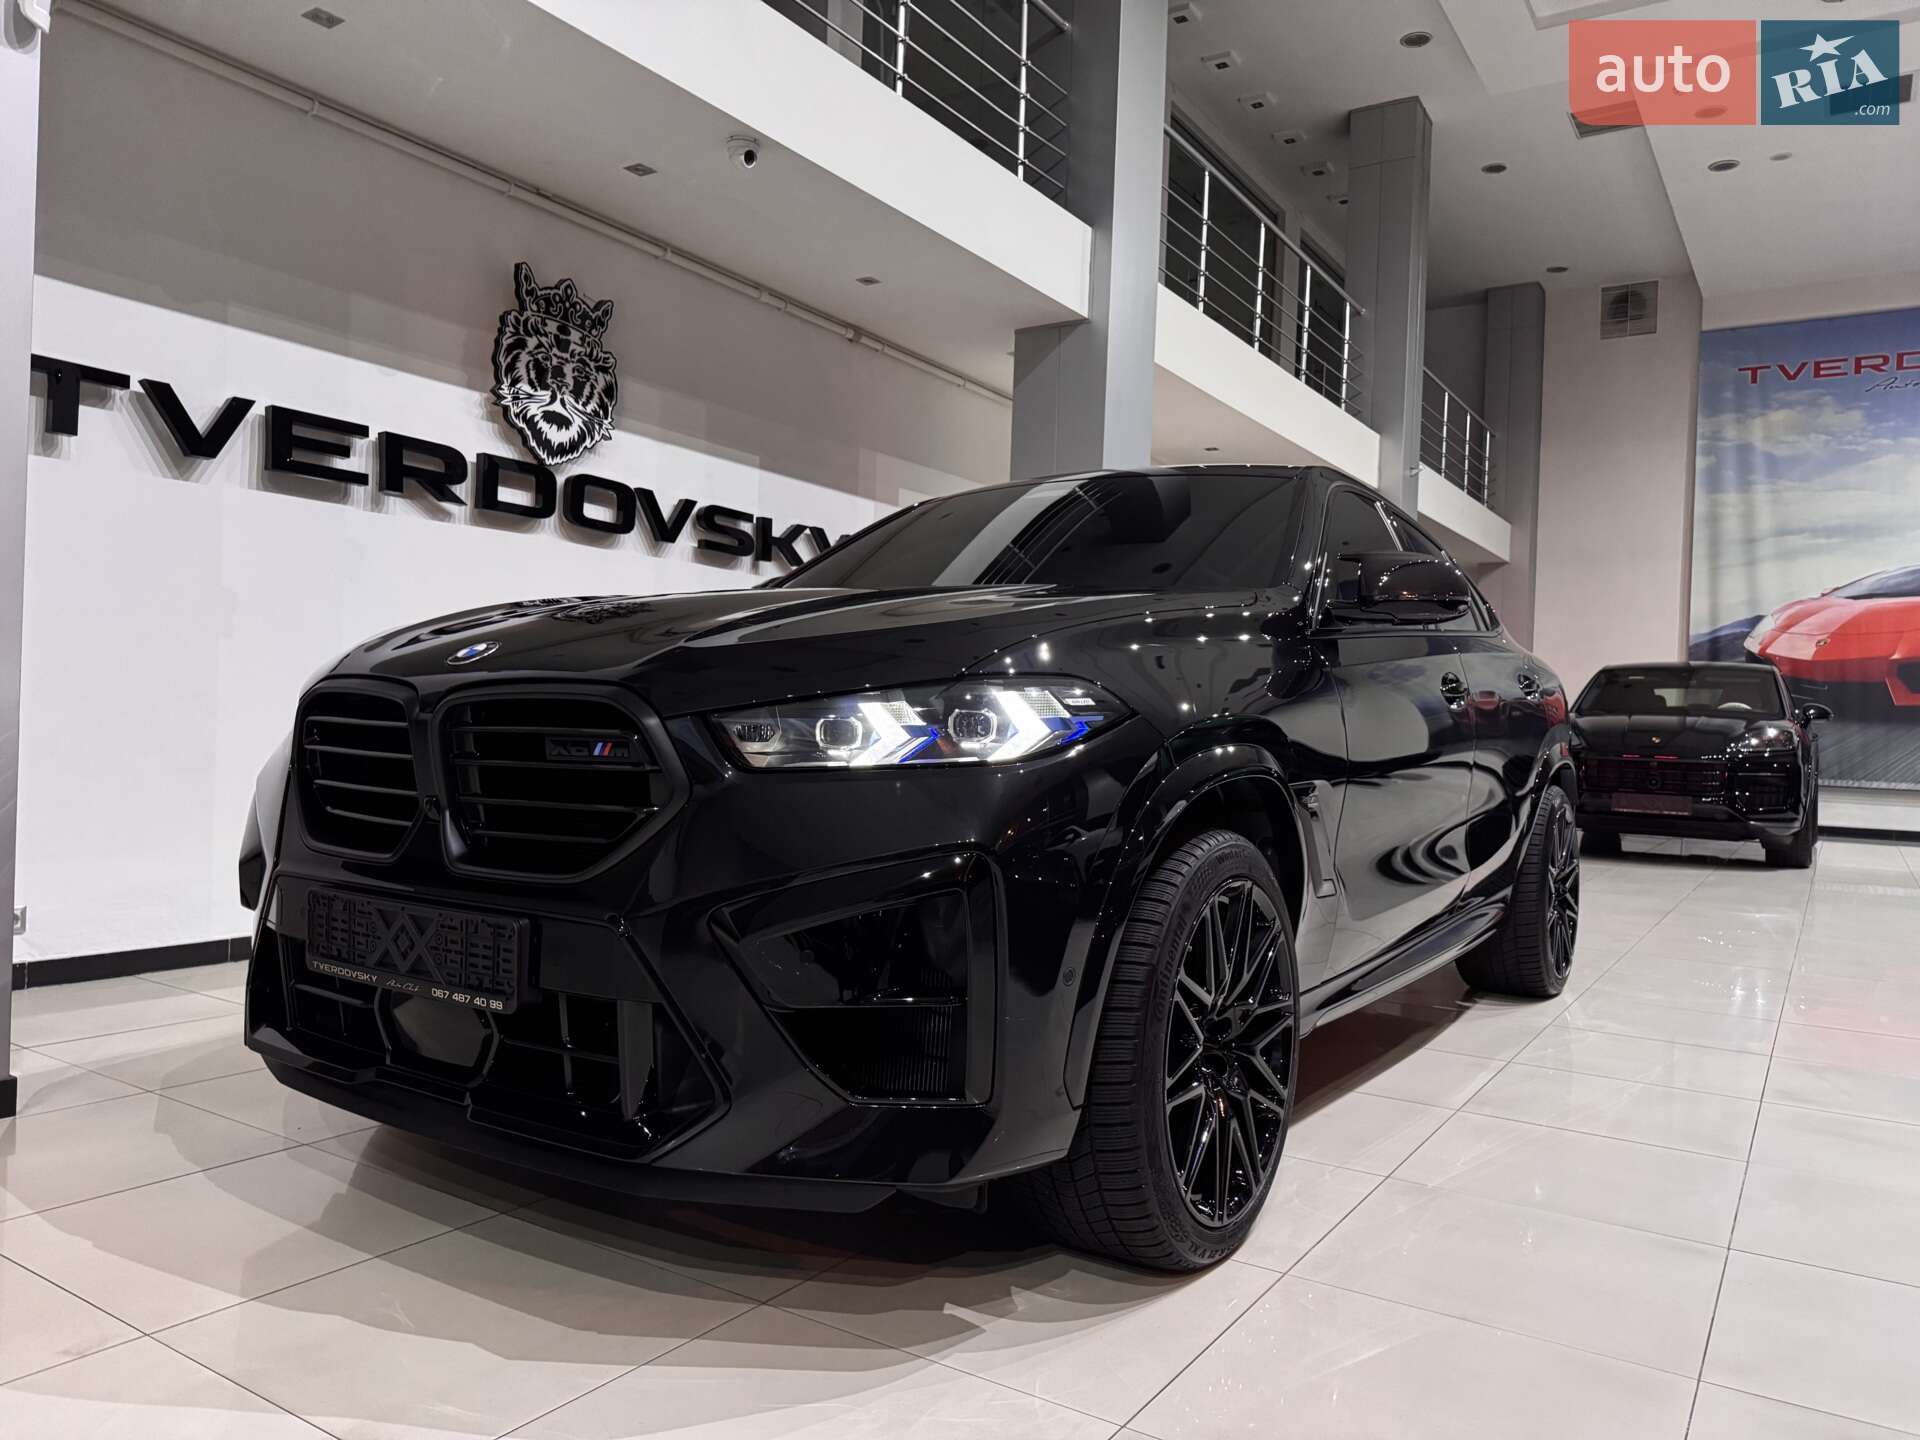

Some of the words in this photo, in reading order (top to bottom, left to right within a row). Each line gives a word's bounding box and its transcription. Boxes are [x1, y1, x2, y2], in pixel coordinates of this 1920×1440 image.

[312, 961, 378, 983] TVERDOVSKY
[431, 988, 449, 999] 067
[474, 996, 487, 1007] 40
